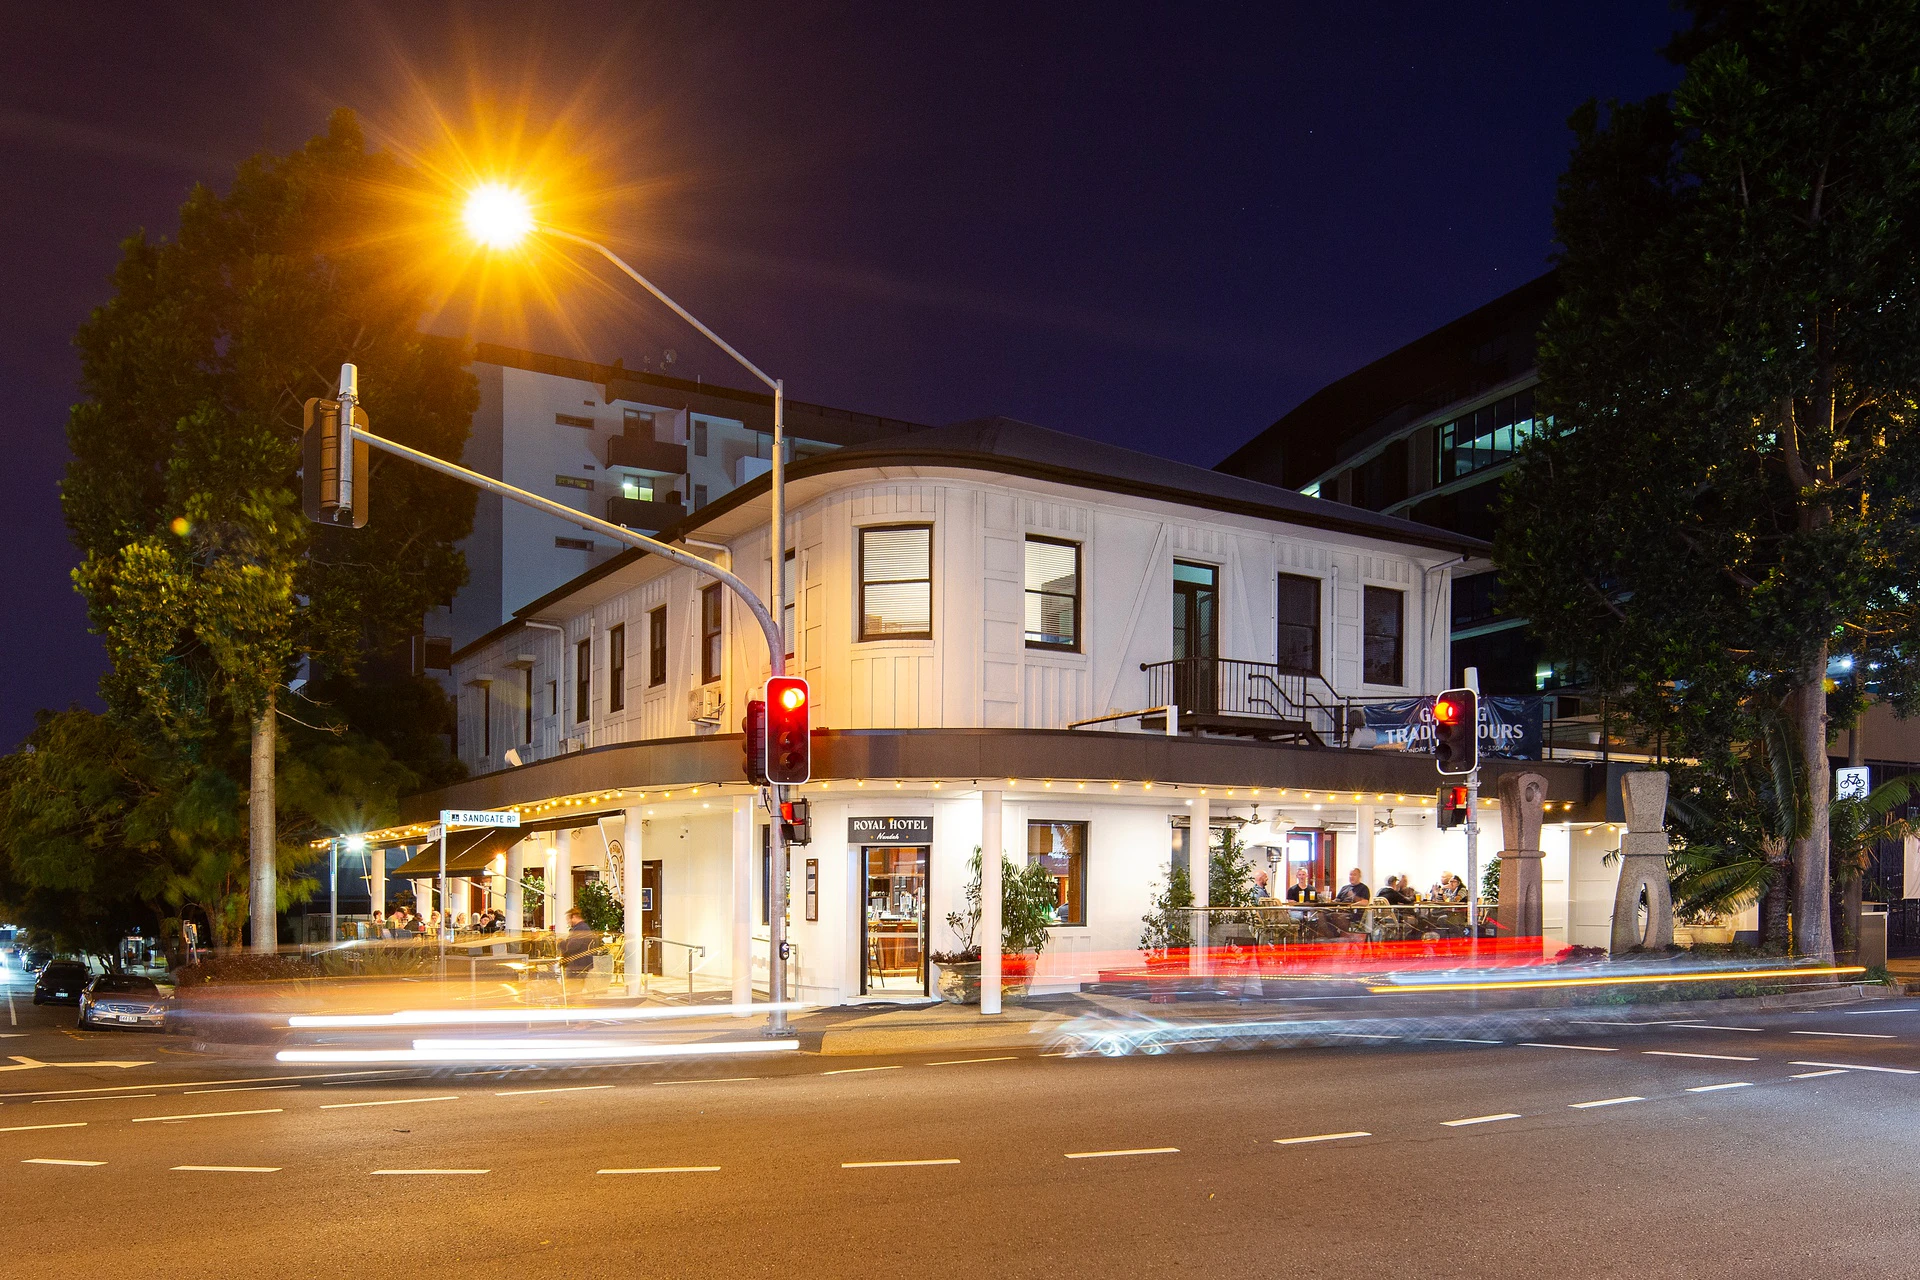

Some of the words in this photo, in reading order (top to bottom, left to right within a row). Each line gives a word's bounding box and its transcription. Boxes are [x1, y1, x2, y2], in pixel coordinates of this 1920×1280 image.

[1385, 726, 1437, 744] TRADI
[1478, 723, 1524, 740] OURS
[462, 813, 504, 823] SANDGATE
[506, 815, 516, 824] RD
[853, 820, 886, 831] ROYAL
[889, 819, 928, 830] HOTEL
[876, 832, 900, 840] Nundah
